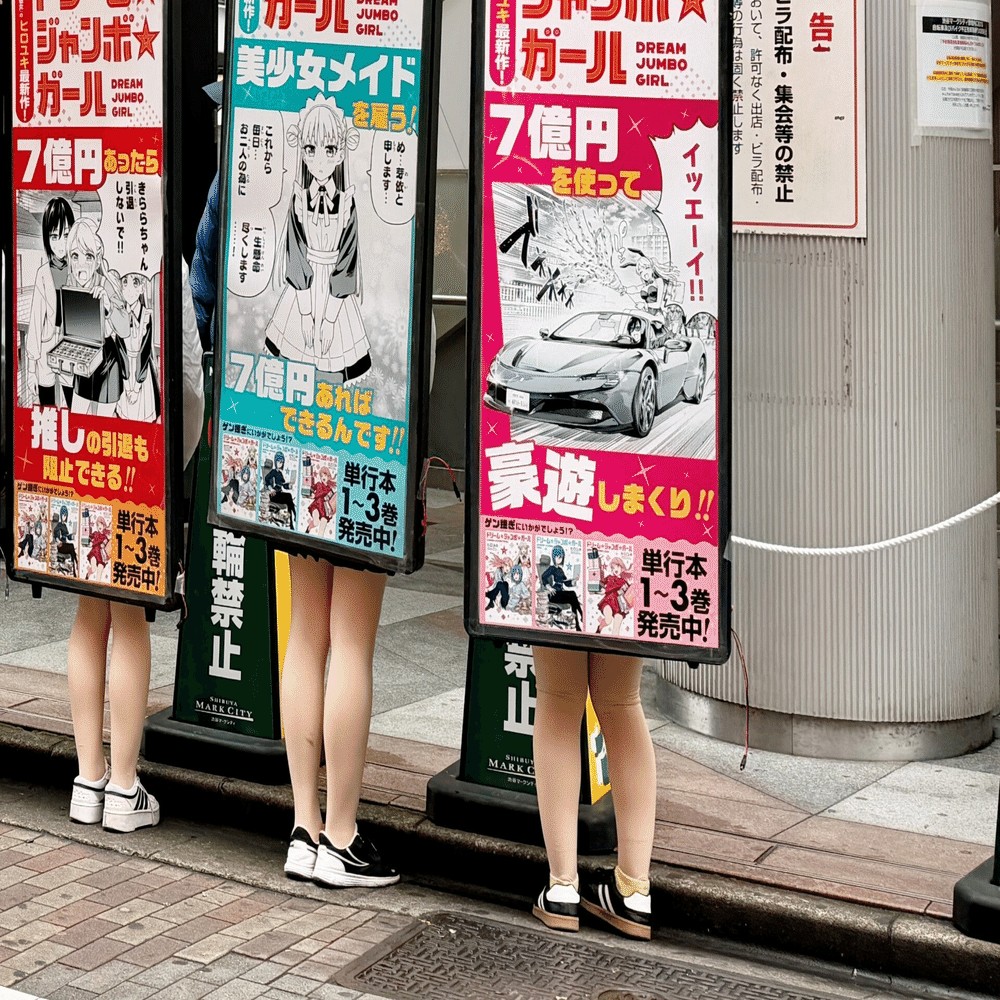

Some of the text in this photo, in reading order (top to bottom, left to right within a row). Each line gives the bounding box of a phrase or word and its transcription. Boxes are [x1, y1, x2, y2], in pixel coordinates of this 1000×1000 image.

[356, 8, 399, 22] JUMBO
[356, 23, 383, 36] GIRL
[521, 27, 627, 84] ガール
[635, 41, 687, 55] DREAM
[236, 44, 416, 98] 美少女メイド
[635, 58, 687, 71] JUMBO
[37, 70, 107, 118] ガール
[111, 78, 143, 90] DREAM
[635, 73, 669, 87] GIRL
[111, 92, 144, 104] JUMBO
[112, 106, 133, 118] GIRL
[489, 103, 619, 163] 7億円
[264, 125, 273, 174] これから
[125, 180, 134, 210] 引退
[551, 166, 641, 198] を使って
[137, 181, 149, 272] きららちゃん
[228, 351, 373, 416] 7億円あれば
[344, 460, 397, 495] 単行本
[116, 509, 159, 538] 単行本
[338, 516, 398, 552] 発売中!
[113, 561, 160, 592] 発売中!
[641, 548, 708, 579] 単行本
[636, 609, 710, 643] 発売中!
[195, 700, 253, 718] MARK CITY
[209, 696, 238, 707] SHIBUYA
[488, 758, 524, 774] MARK
